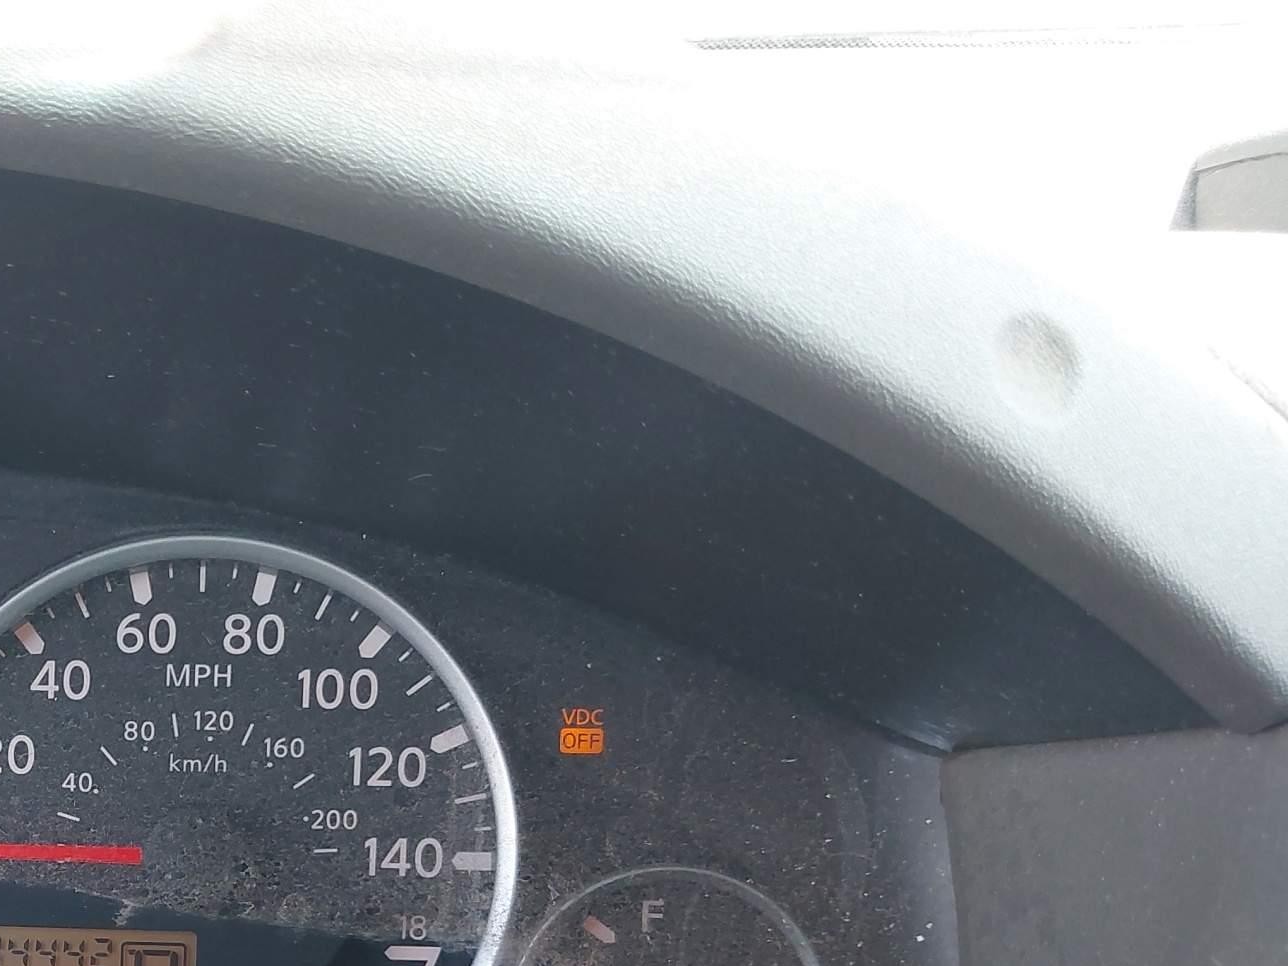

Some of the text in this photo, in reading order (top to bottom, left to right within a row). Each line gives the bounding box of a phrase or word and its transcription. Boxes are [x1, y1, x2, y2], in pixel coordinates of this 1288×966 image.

[116, 613, 177, 654] 60
[224, 614, 285, 655] 80
[30, 660, 91, 700] 40
[165, 665, 232, 688] MPH
[298, 669, 378, 710] 100
[193, 711, 234, 732] 120
[562, 708, 605, 726] VDC
[124, 720, 156, 741] 80
[562, 732, 601, 750] OFF
[264, 737, 305, 758] 160
[169, 754, 228, 774] km/h
[349, 746, 427, 787] 120
[311, 809, 358, 830] 200
[364, 838, 443, 878] 140
[400, 915, 427, 940] 18
[641, 899, 665, 932] F
